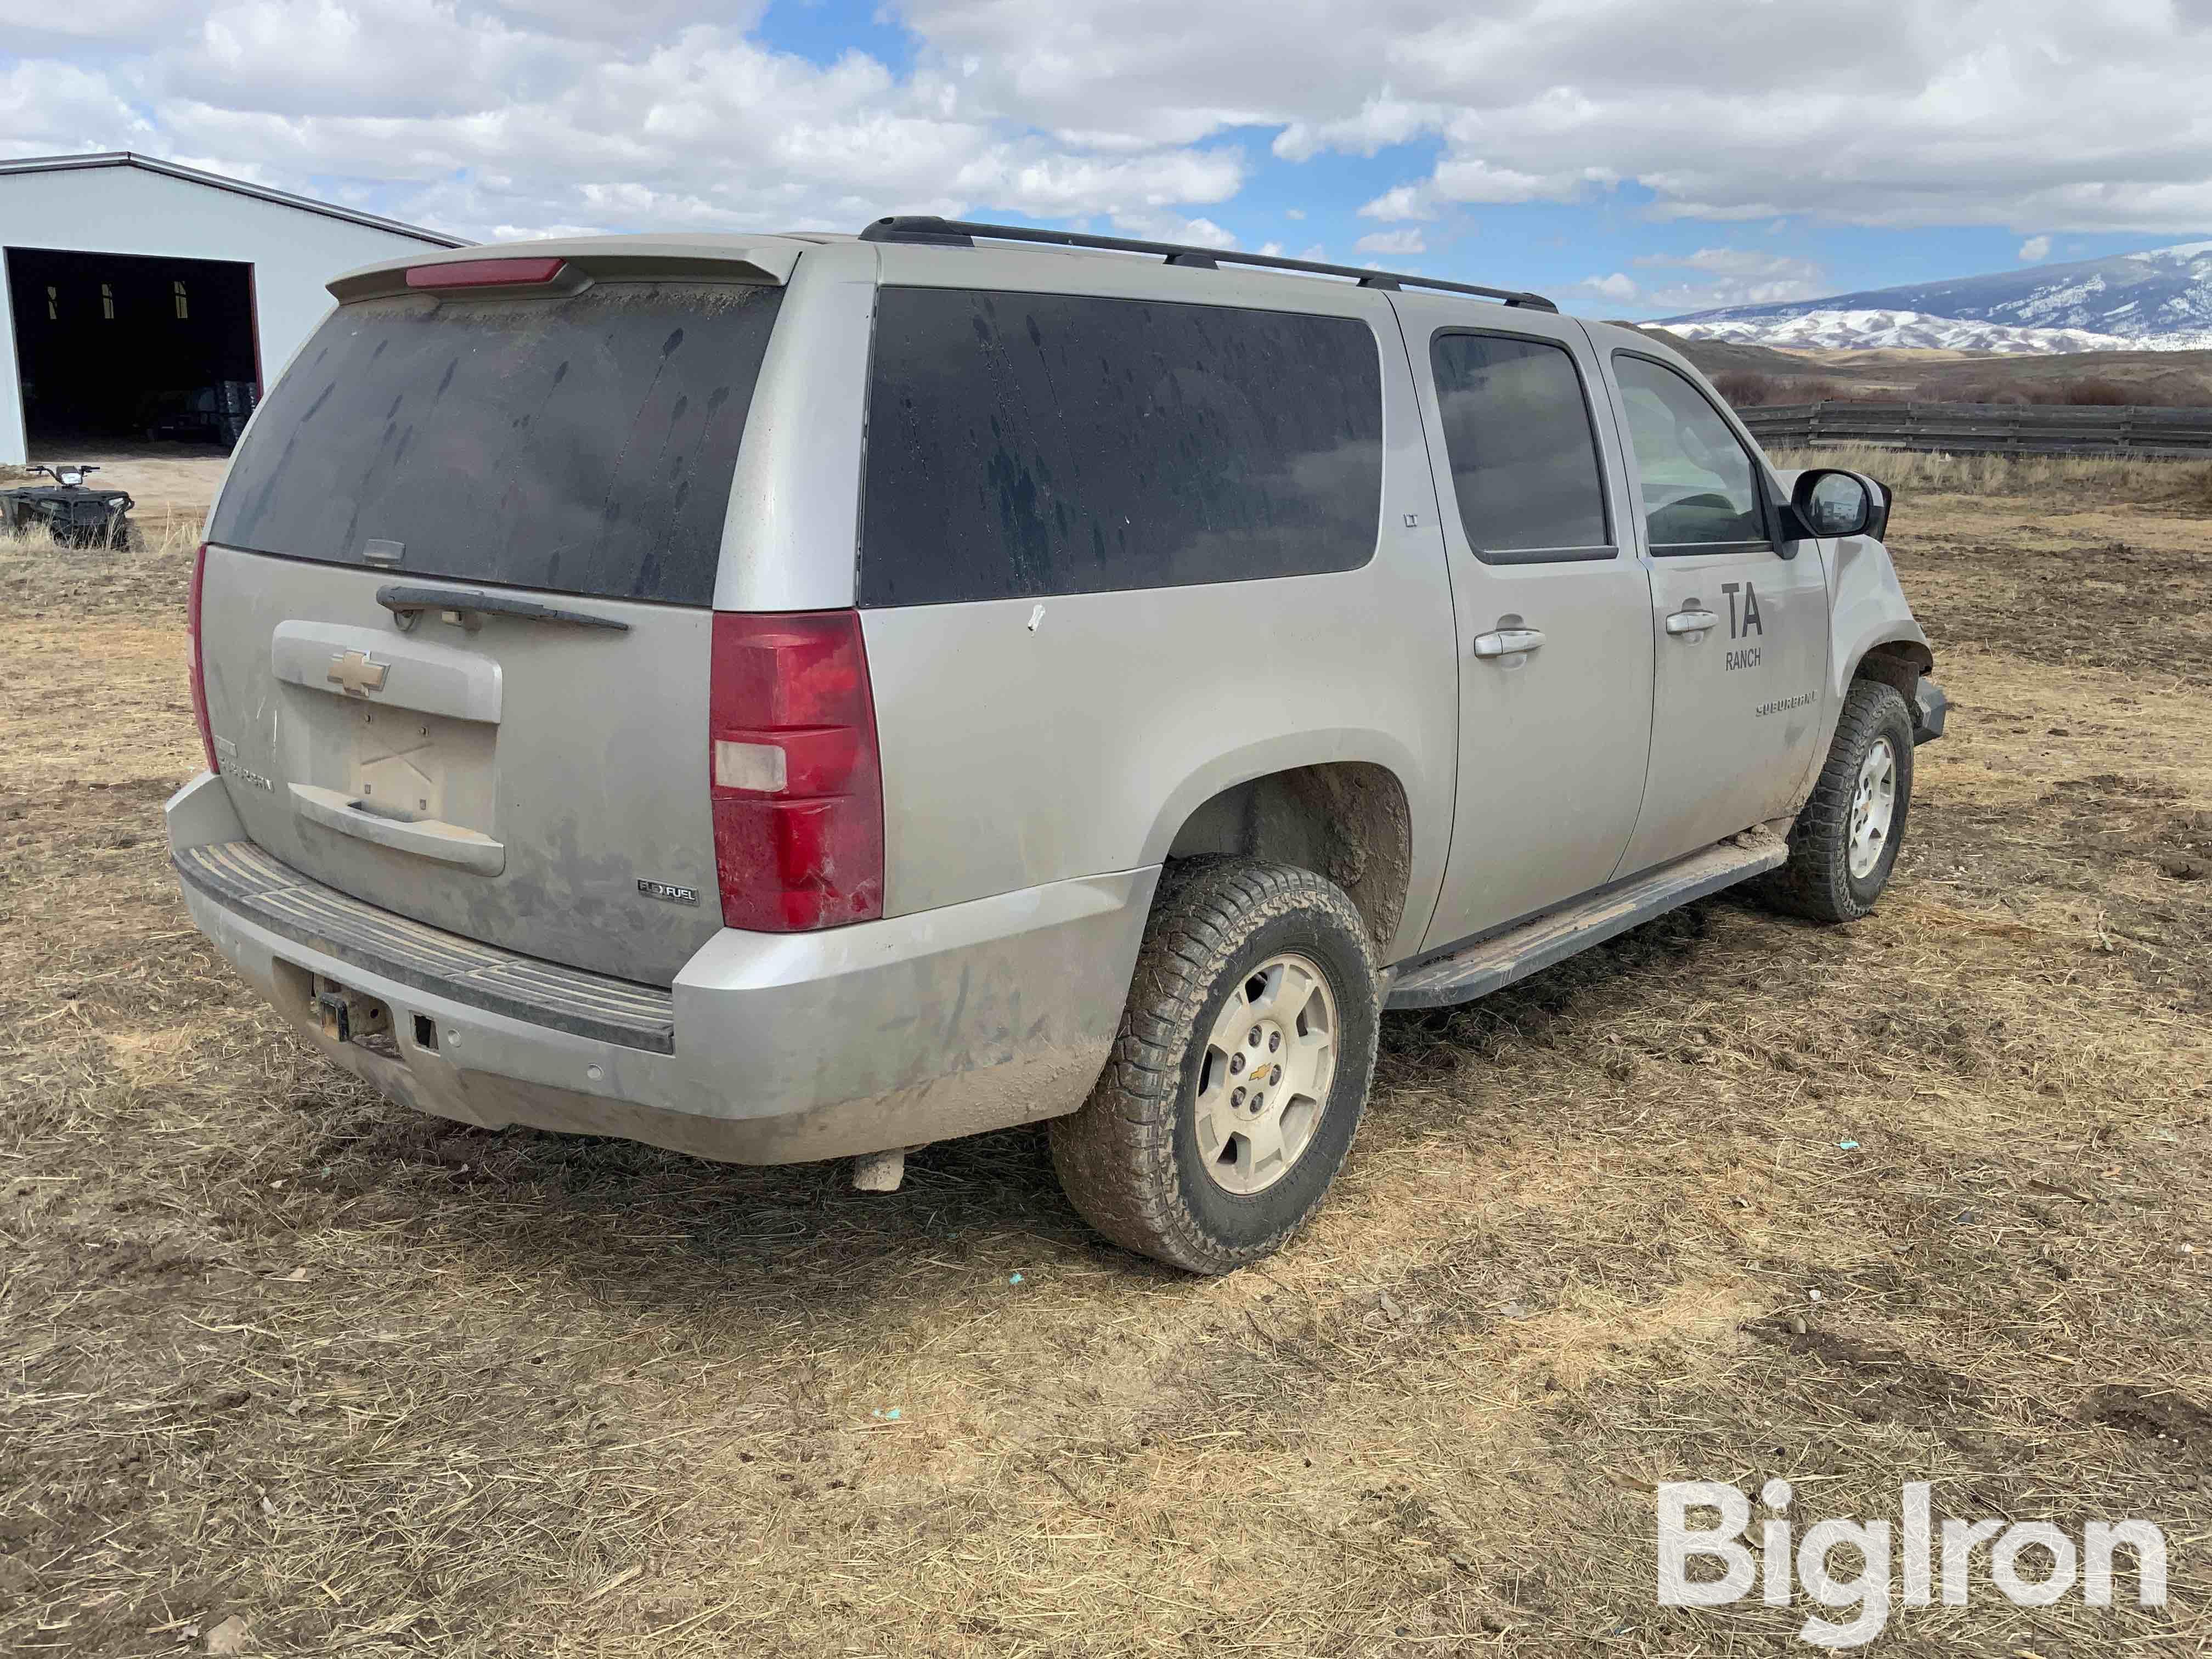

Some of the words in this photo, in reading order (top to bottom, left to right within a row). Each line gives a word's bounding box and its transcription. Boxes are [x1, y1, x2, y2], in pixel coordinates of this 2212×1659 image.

[1403, 514, 1418, 527] LT
[1721, 582, 1763, 639] TA
[1725, 648, 1761, 671] RANCH
[1755, 690, 1817, 717] SUBURBAN
